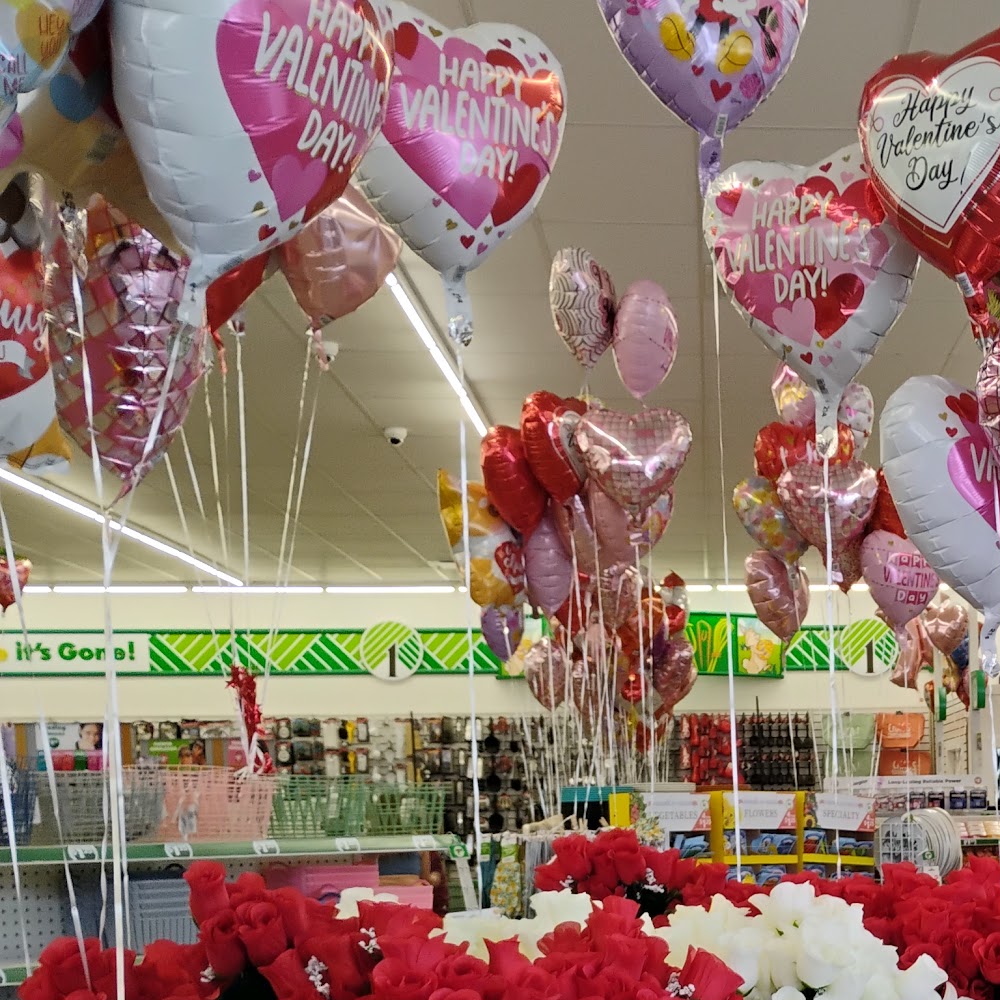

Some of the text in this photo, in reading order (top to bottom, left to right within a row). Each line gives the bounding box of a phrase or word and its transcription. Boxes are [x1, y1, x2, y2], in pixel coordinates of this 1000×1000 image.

[439, 52, 525, 101] HAPPY
[400, 81, 555, 156] VALENTINE'S
[893, 85, 976, 127] Happy
[297, 108, 357, 173] DAY!
[876, 112, 1000, 168] Valentine's
[458, 140, 520, 184] DAY!
[752, 190, 835, 231] HAPPY
[725, 210, 873, 274] VALENTINE'S
[774, 268, 829, 303] DAY!
[16, 641, 135, 661] it's Gone!
[744, 808, 777, 818] FLOWERS
[822, 809, 860, 820] SPECIALTY
